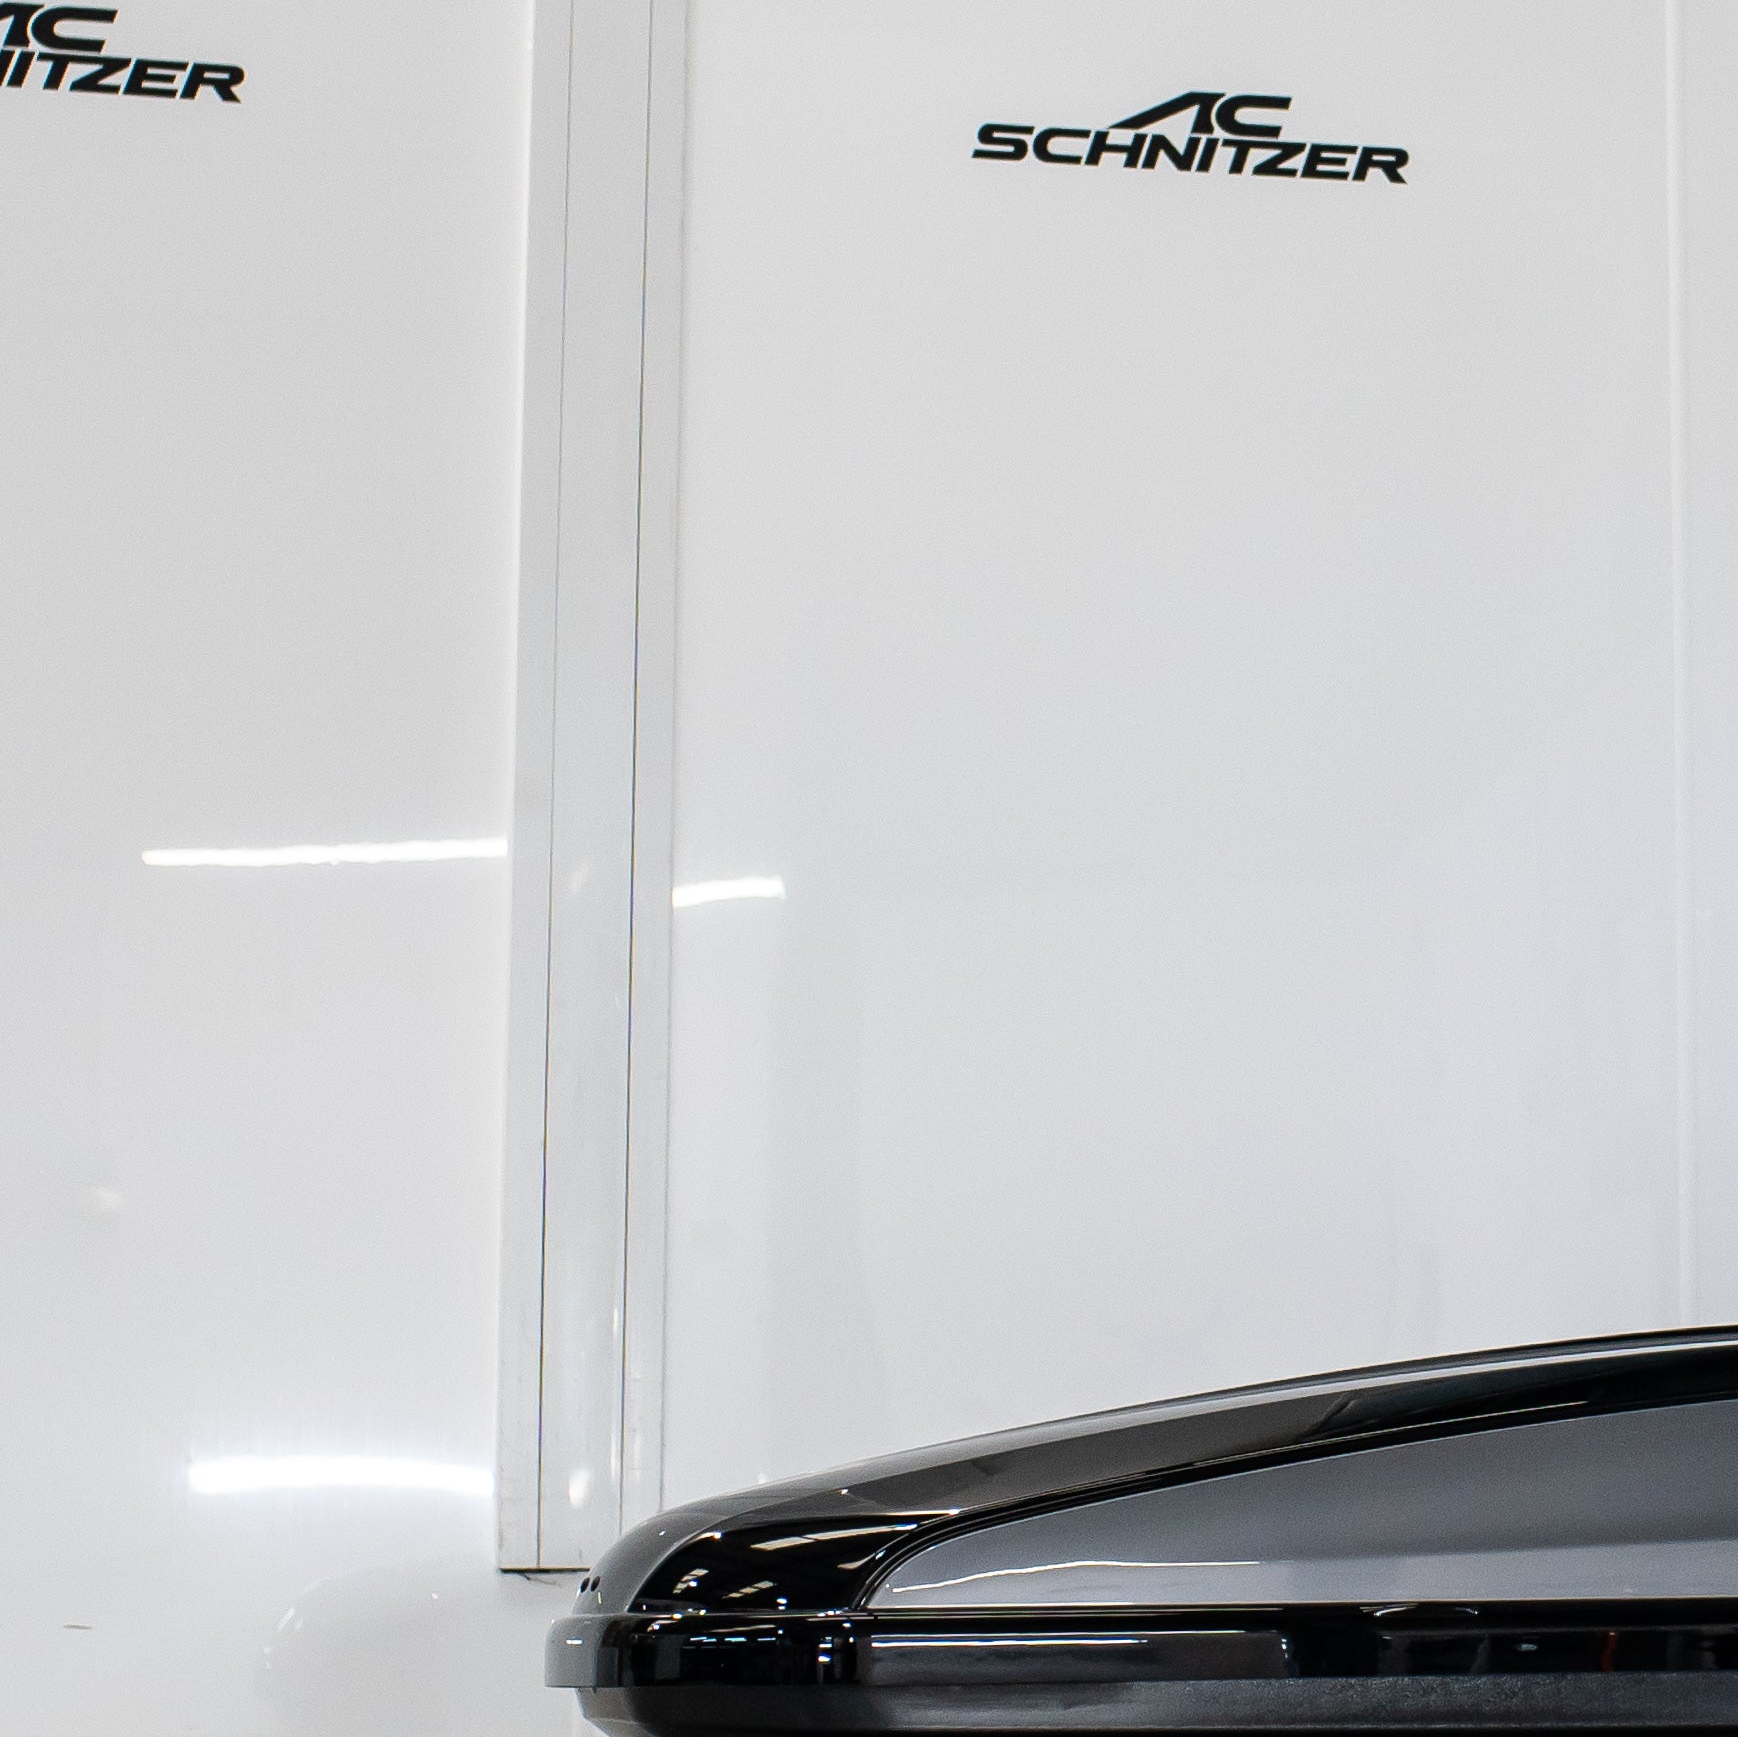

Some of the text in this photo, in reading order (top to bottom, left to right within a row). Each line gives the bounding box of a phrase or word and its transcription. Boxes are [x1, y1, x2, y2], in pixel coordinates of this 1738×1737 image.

[0, 48, 246, 104] ITZER
[1107, 91, 1293, 139] AC
[971, 123, 1409, 184] SCHNITZER
